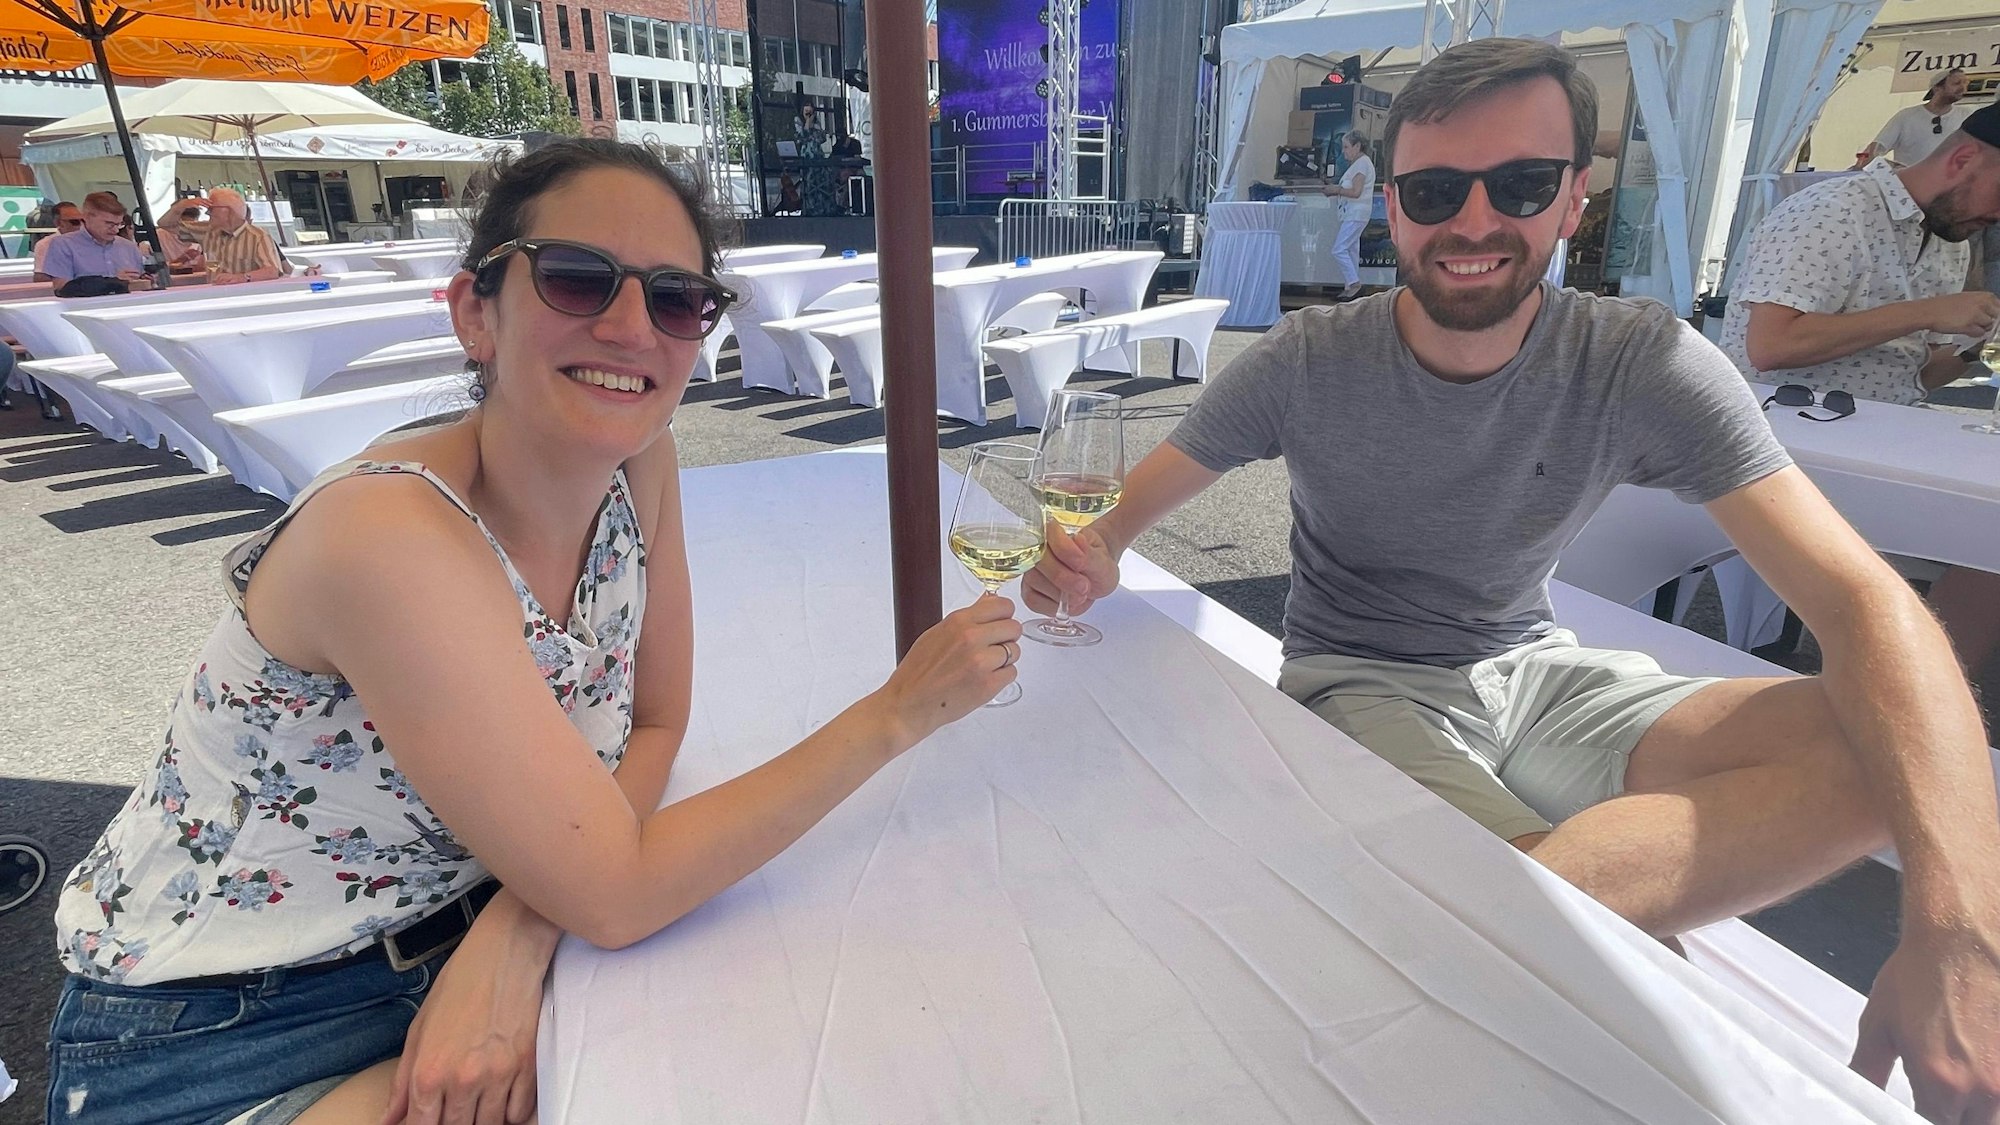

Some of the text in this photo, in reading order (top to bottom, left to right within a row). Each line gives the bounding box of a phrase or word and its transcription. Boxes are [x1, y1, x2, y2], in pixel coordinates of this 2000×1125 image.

[327, 0, 470, 41] WEIZEN
[1901, 50, 1977, 73] Zum
[952, 118, 961, 133] 1.
